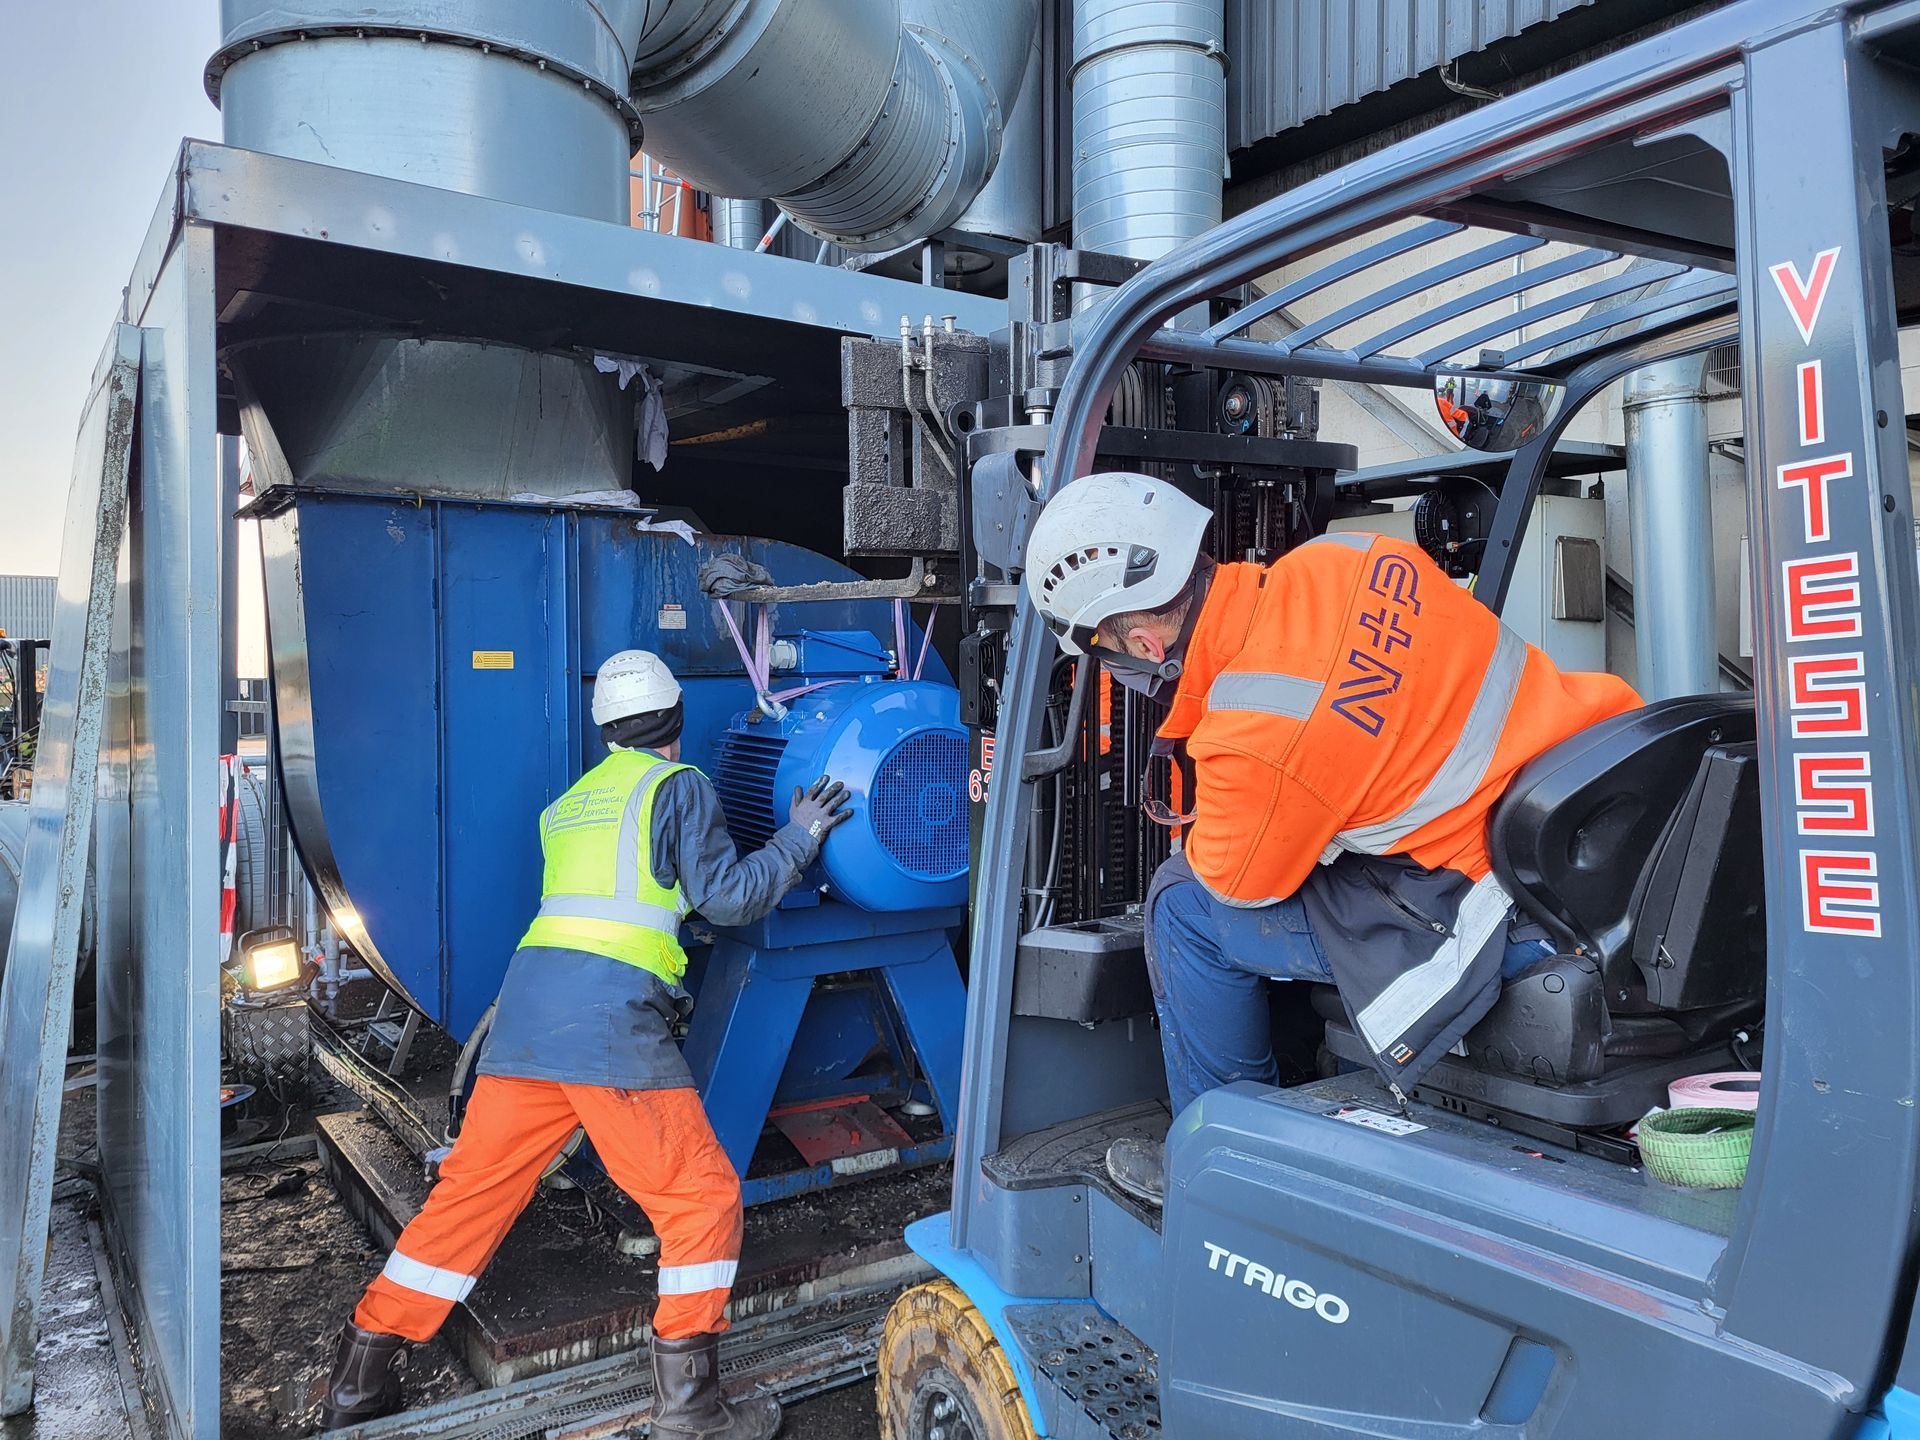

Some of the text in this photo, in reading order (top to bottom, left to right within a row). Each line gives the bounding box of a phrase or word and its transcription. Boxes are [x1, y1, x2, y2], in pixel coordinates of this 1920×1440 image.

[1769, 246, 1881, 938] VITESSE
[592, 786, 615, 796] STELLO
[588, 796, 624, 806] TECHNICAL
[584, 807, 609, 818] SERVICE
[1204, 1240, 1350, 1324] TRAIGO
